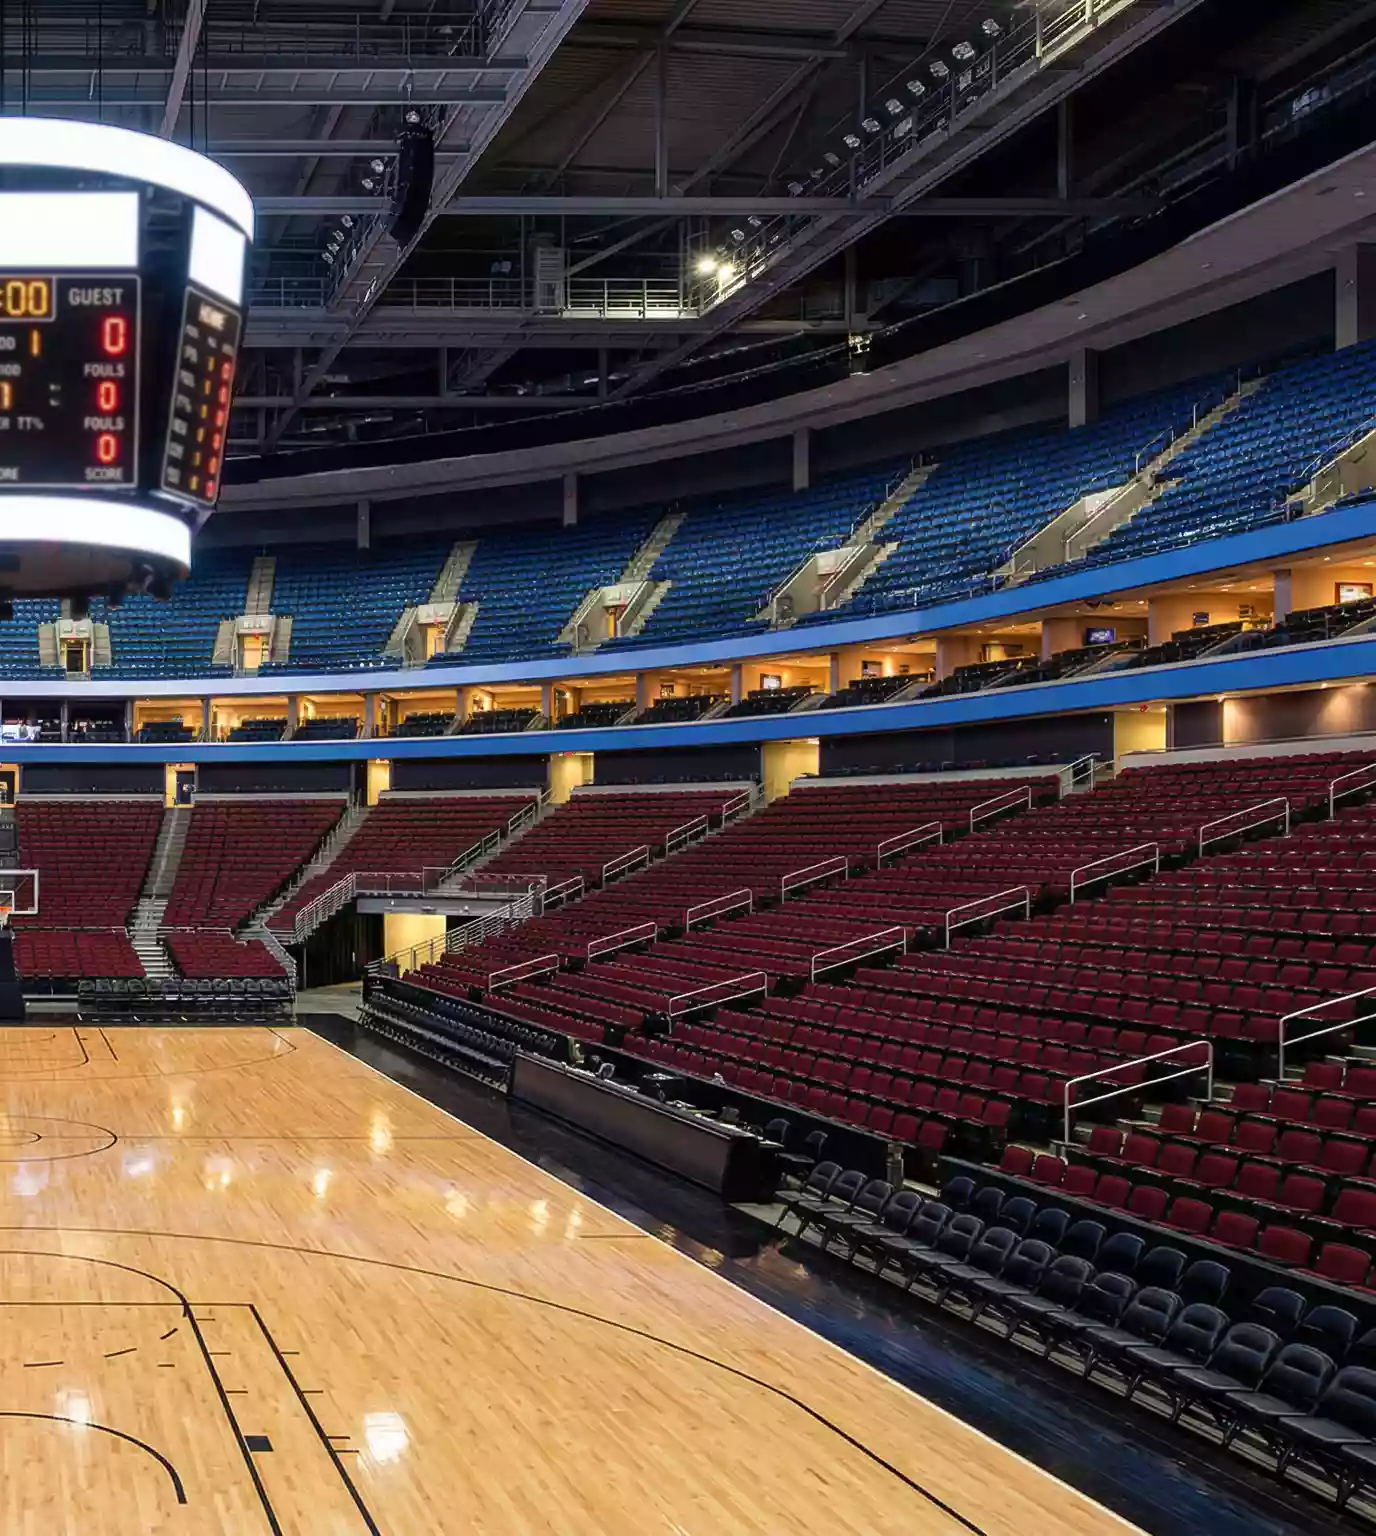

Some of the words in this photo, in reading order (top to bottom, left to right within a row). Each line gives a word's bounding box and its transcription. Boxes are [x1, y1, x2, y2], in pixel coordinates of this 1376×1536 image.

[68, 287, 124, 306] GUEST
[31, 329, 40, 357] 1
[103, 316, 126, 354] 0
[83, 363, 125, 377] FOULS
[99, 381, 117, 411] 0
[83, 416, 125, 431] FOULS
[98, 433, 117, 462] 0
